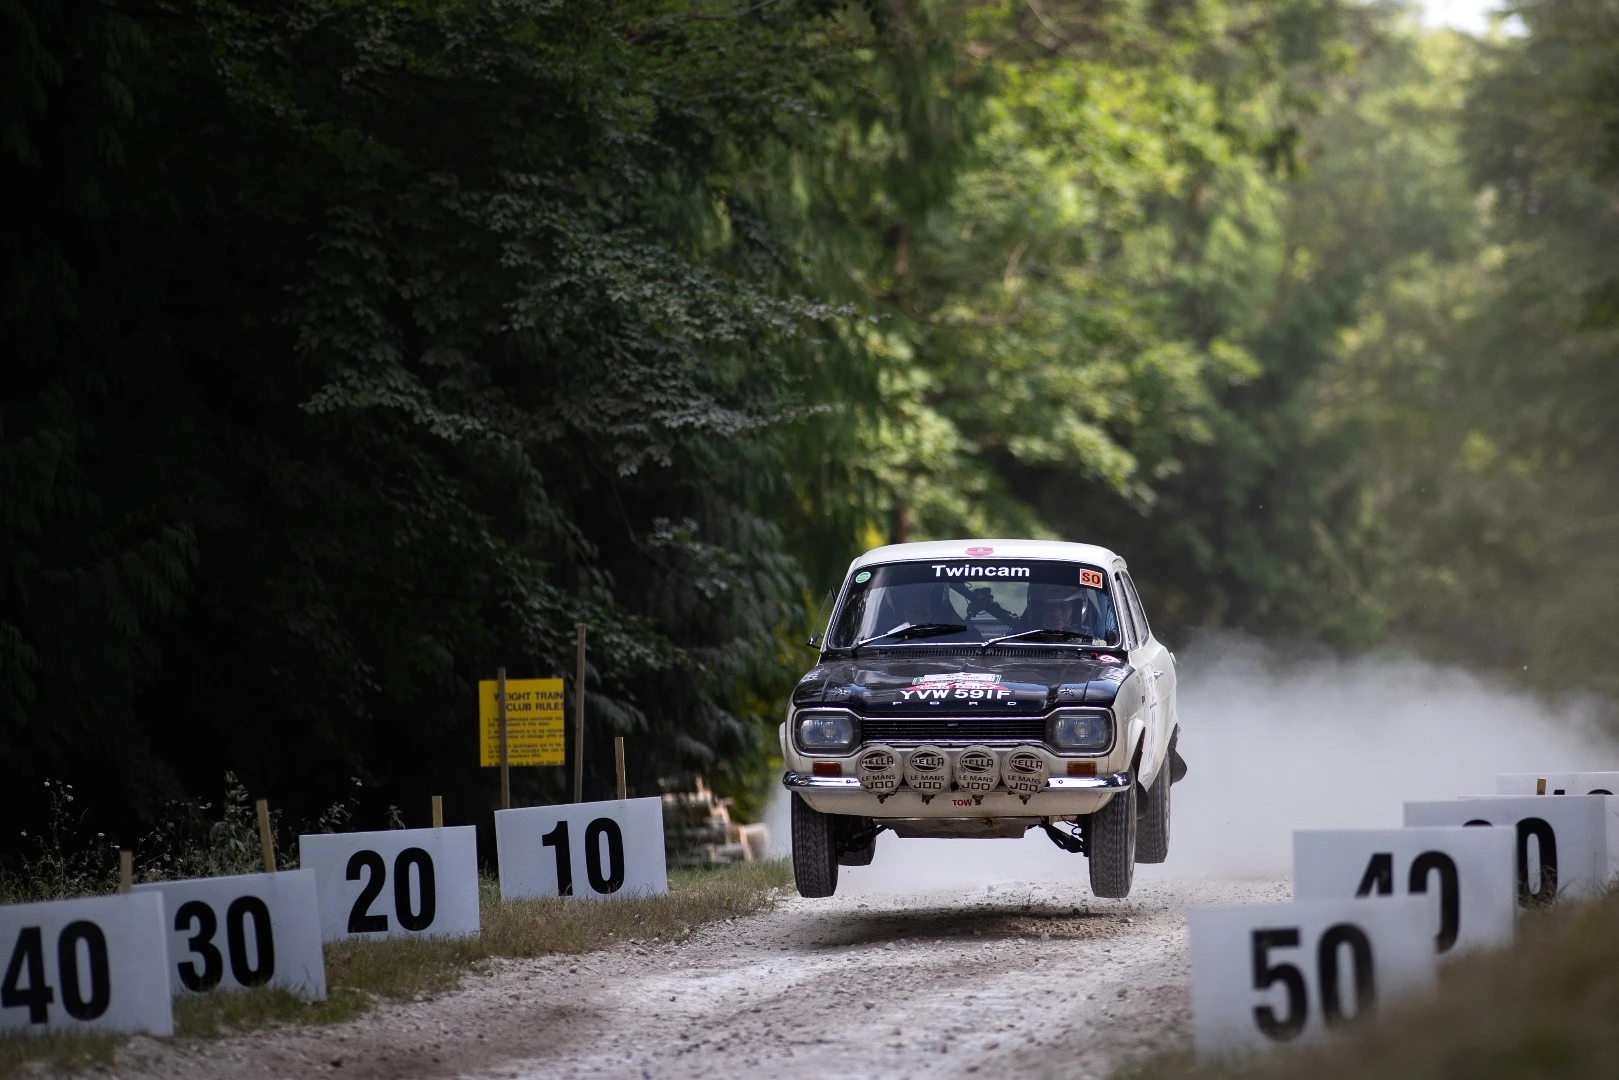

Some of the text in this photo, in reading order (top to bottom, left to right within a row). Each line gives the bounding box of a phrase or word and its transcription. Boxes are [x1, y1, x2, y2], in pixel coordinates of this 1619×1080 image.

[931, 564, 1031, 577] Twincam
[899, 689, 1012, 700] YVW 591F
[506, 702, 532, 711] CLUB
[861, 755, 894, 766] HELLA
[911, 757, 945, 766] HELLA
[961, 758, 993, 768] HELLA
[1011, 759, 1043, 770] HELLA
[1018, 776, 1042, 784] MANS
[541, 817, 625, 896] 10
[345, 847, 436, 934] 20
[174, 895, 275, 993] 30
[1, 919, 111, 1024] 40
[1251, 922, 1378, 1042] 50
